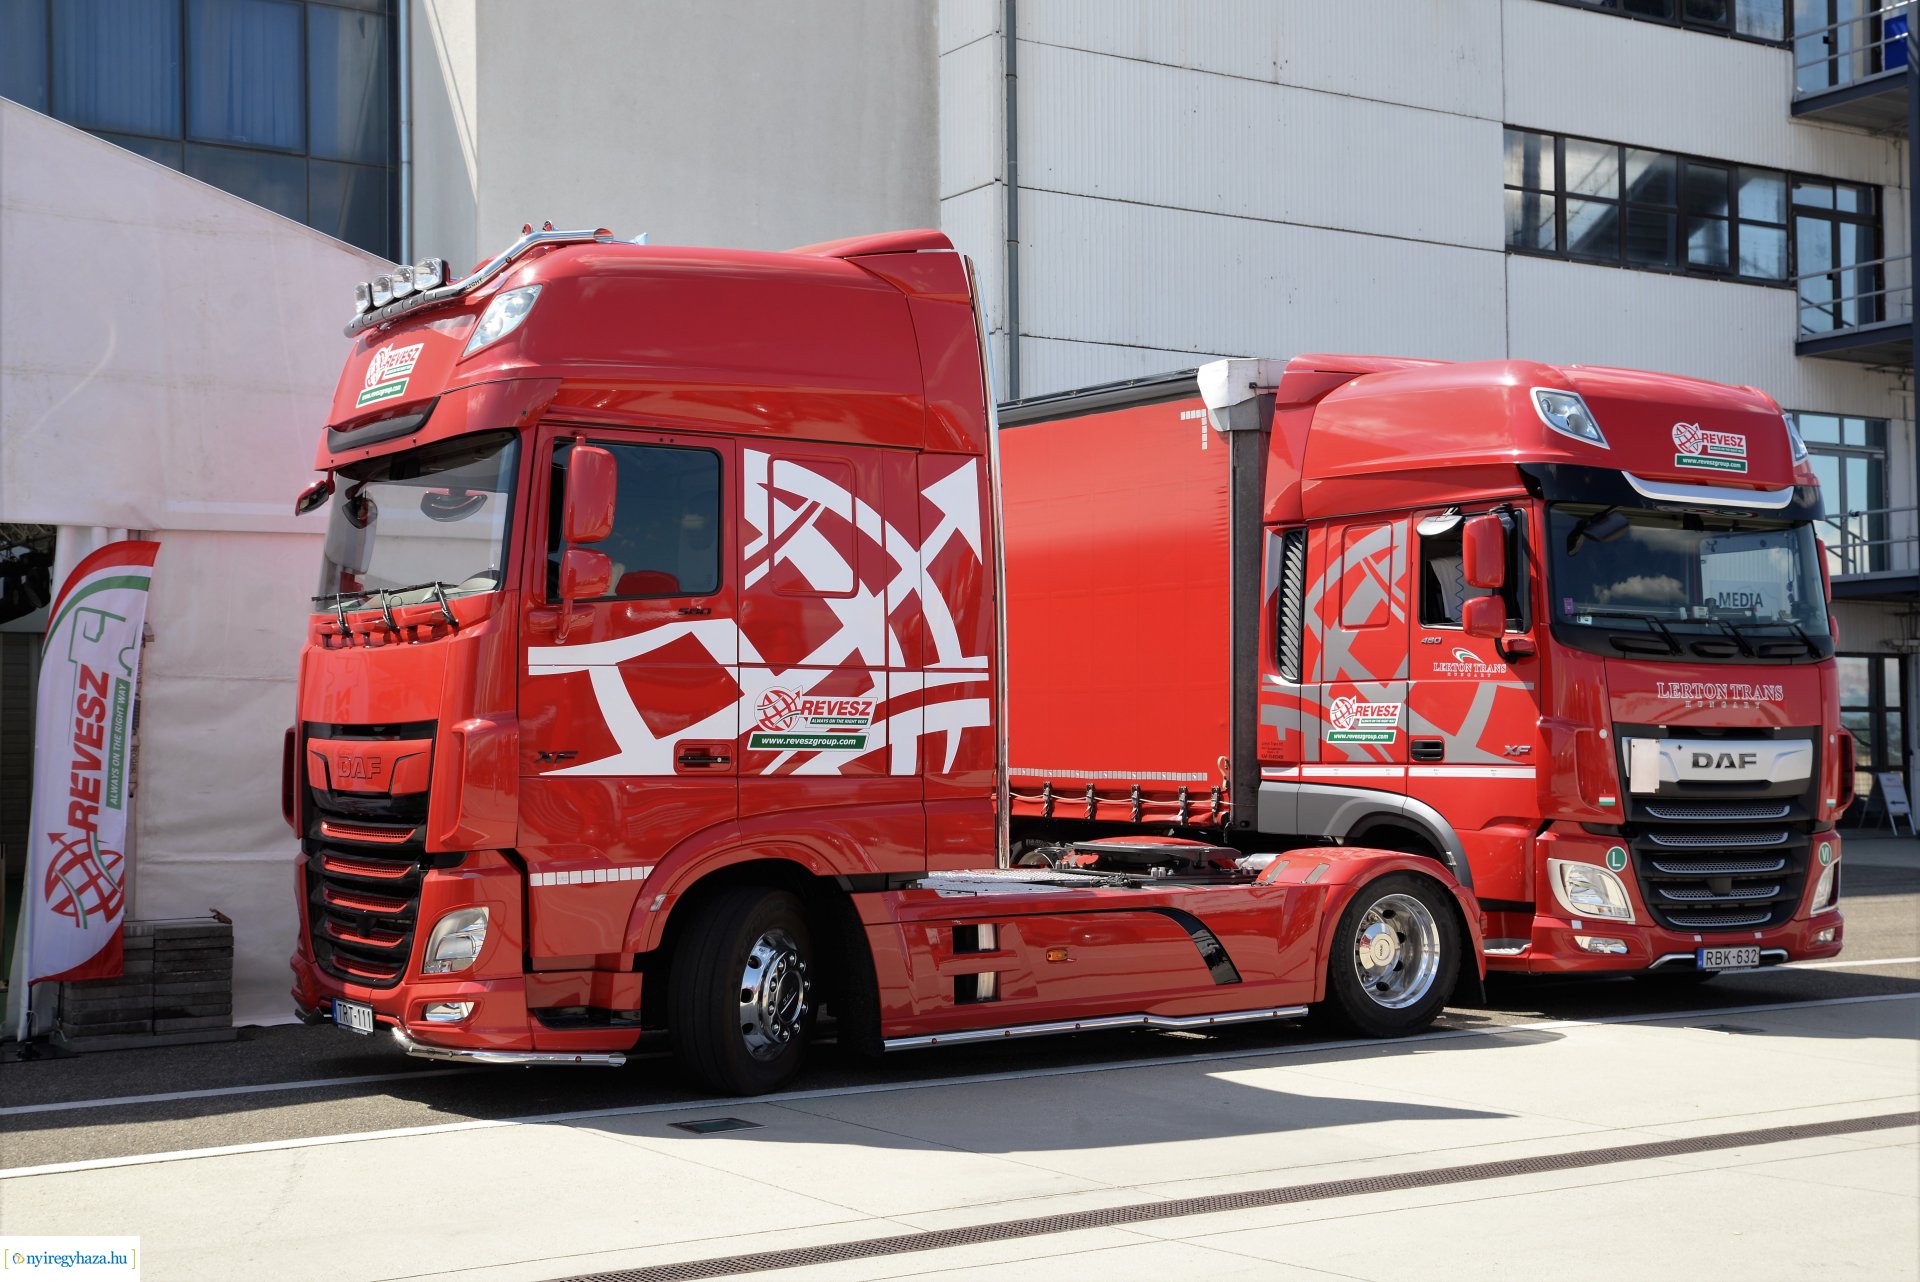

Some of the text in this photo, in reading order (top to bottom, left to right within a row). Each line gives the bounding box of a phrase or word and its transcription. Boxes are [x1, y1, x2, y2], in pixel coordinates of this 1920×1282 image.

[1701, 432, 1744, 448] REVESZ
[1718, 592, 1764, 608] MEDIA
[1474, 663, 1507, 673] TRANS
[1656, 682, 1784, 701] LERTON TRANS
[800, 700, 873, 717] REVESZ
[1355, 705, 1399, 717] REVESZ
[1685, 700, 1761, 709] HUNGARY
[110, 683, 127, 805] ALWAYS ON THE RIGHT WAY
[761, 736, 856, 747] www.reveszgroup.com
[1333, 733, 1389, 741] www.reveszgroup.com
[67, 663, 110, 833] REVESZ
[1504, 745, 1532, 756] XF
[534, 750, 579, 764] XF
[1691, 752, 1757, 769] DAF
[338, 755, 382, 780] DAF
[1612, 851, 1622, 867] L
[1705, 949, 1757, 966] RBK-632
[337, 1002, 372, 1030] TRT-111
